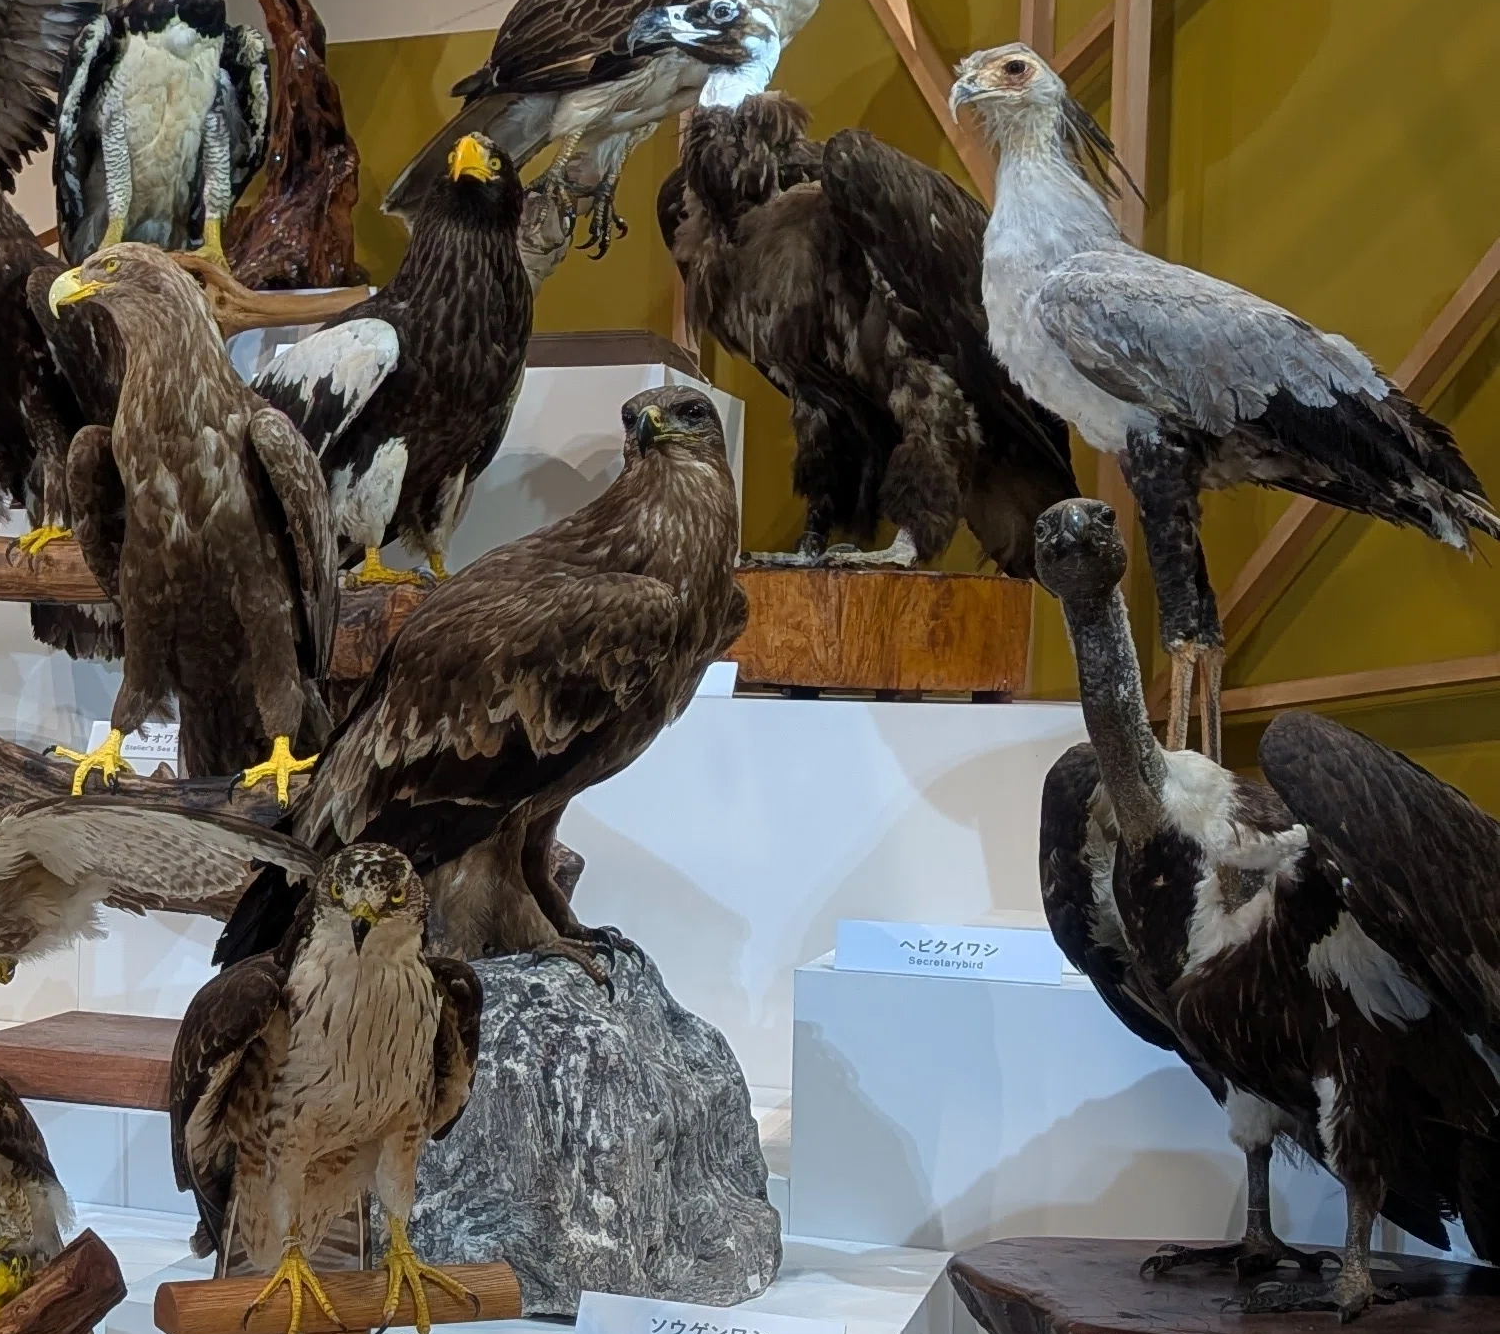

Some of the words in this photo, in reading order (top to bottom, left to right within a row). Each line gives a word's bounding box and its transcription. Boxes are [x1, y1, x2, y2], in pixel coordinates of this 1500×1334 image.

[900, 939, 999, 957] ヘビクイワシ
[908, 956, 983, 970] Secretarybird
